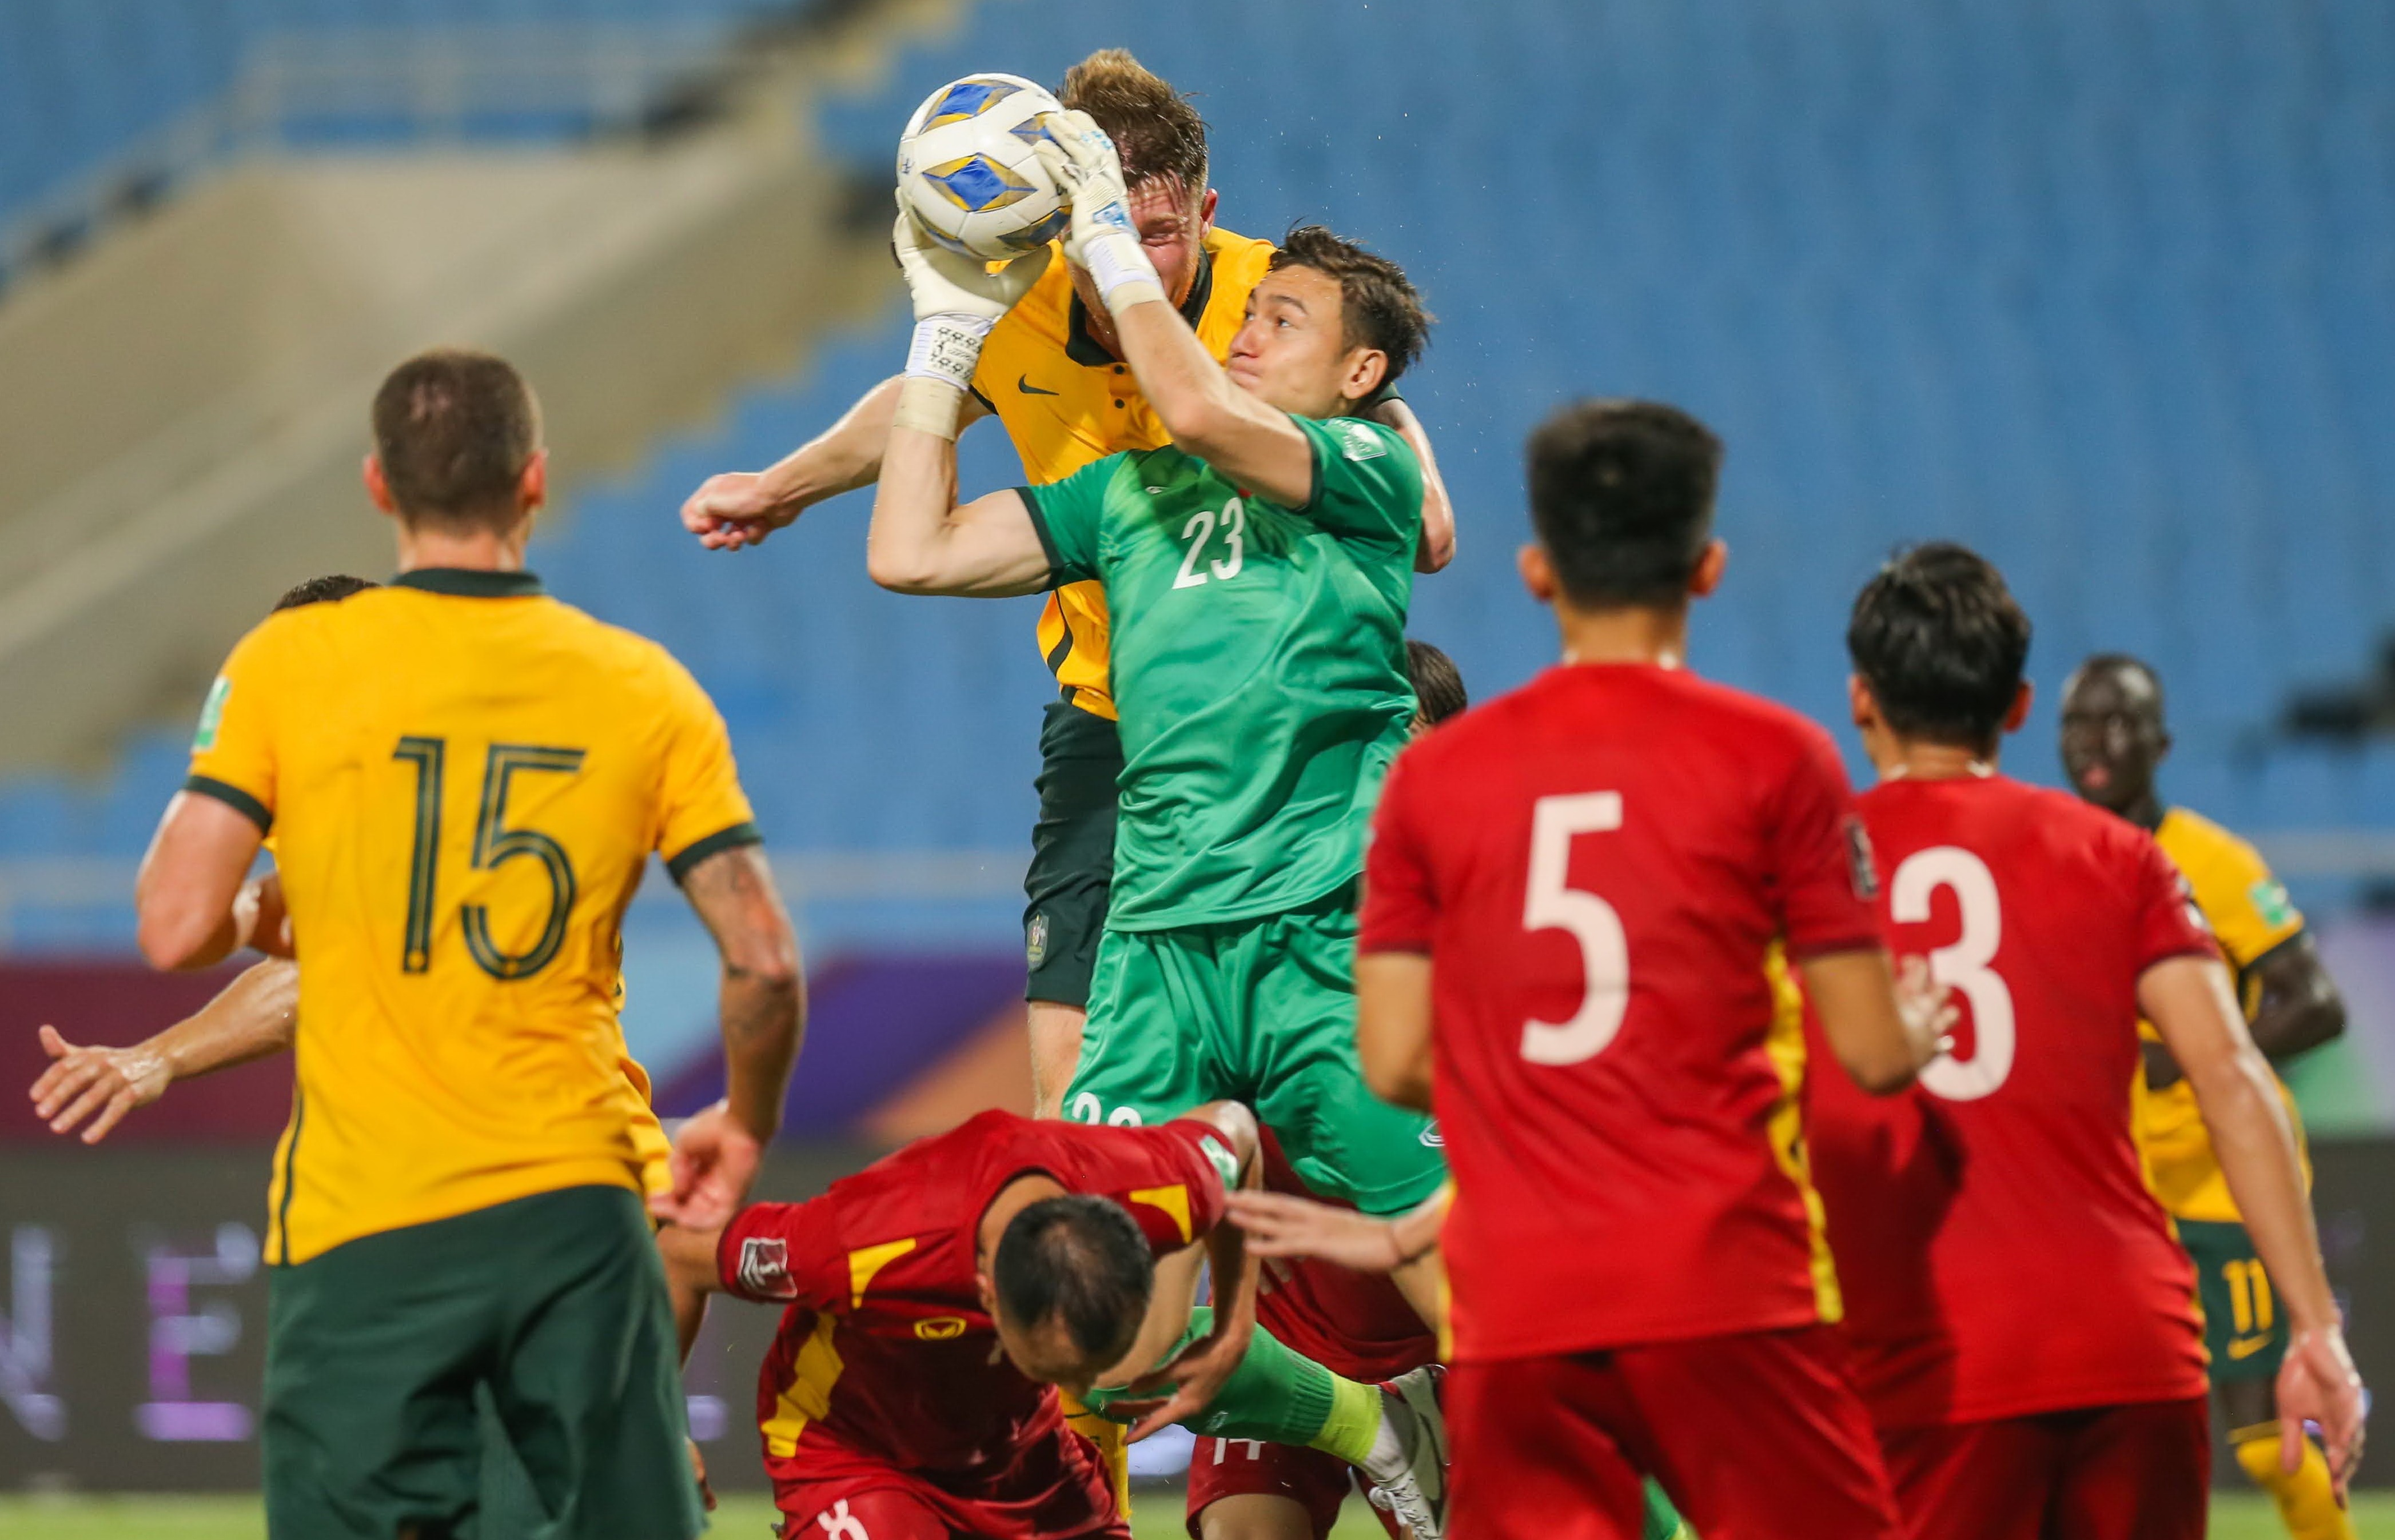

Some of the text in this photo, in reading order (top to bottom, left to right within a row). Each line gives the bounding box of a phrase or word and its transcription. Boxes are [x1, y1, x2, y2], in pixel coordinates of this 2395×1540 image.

[1171, 497, 1244, 589] 23
[393, 736, 587, 980] 15
[1519, 790, 1630, 1067] 5
[1891, 845, 2016, 1101] 3
[2221, 1258, 2274, 1334] 11
